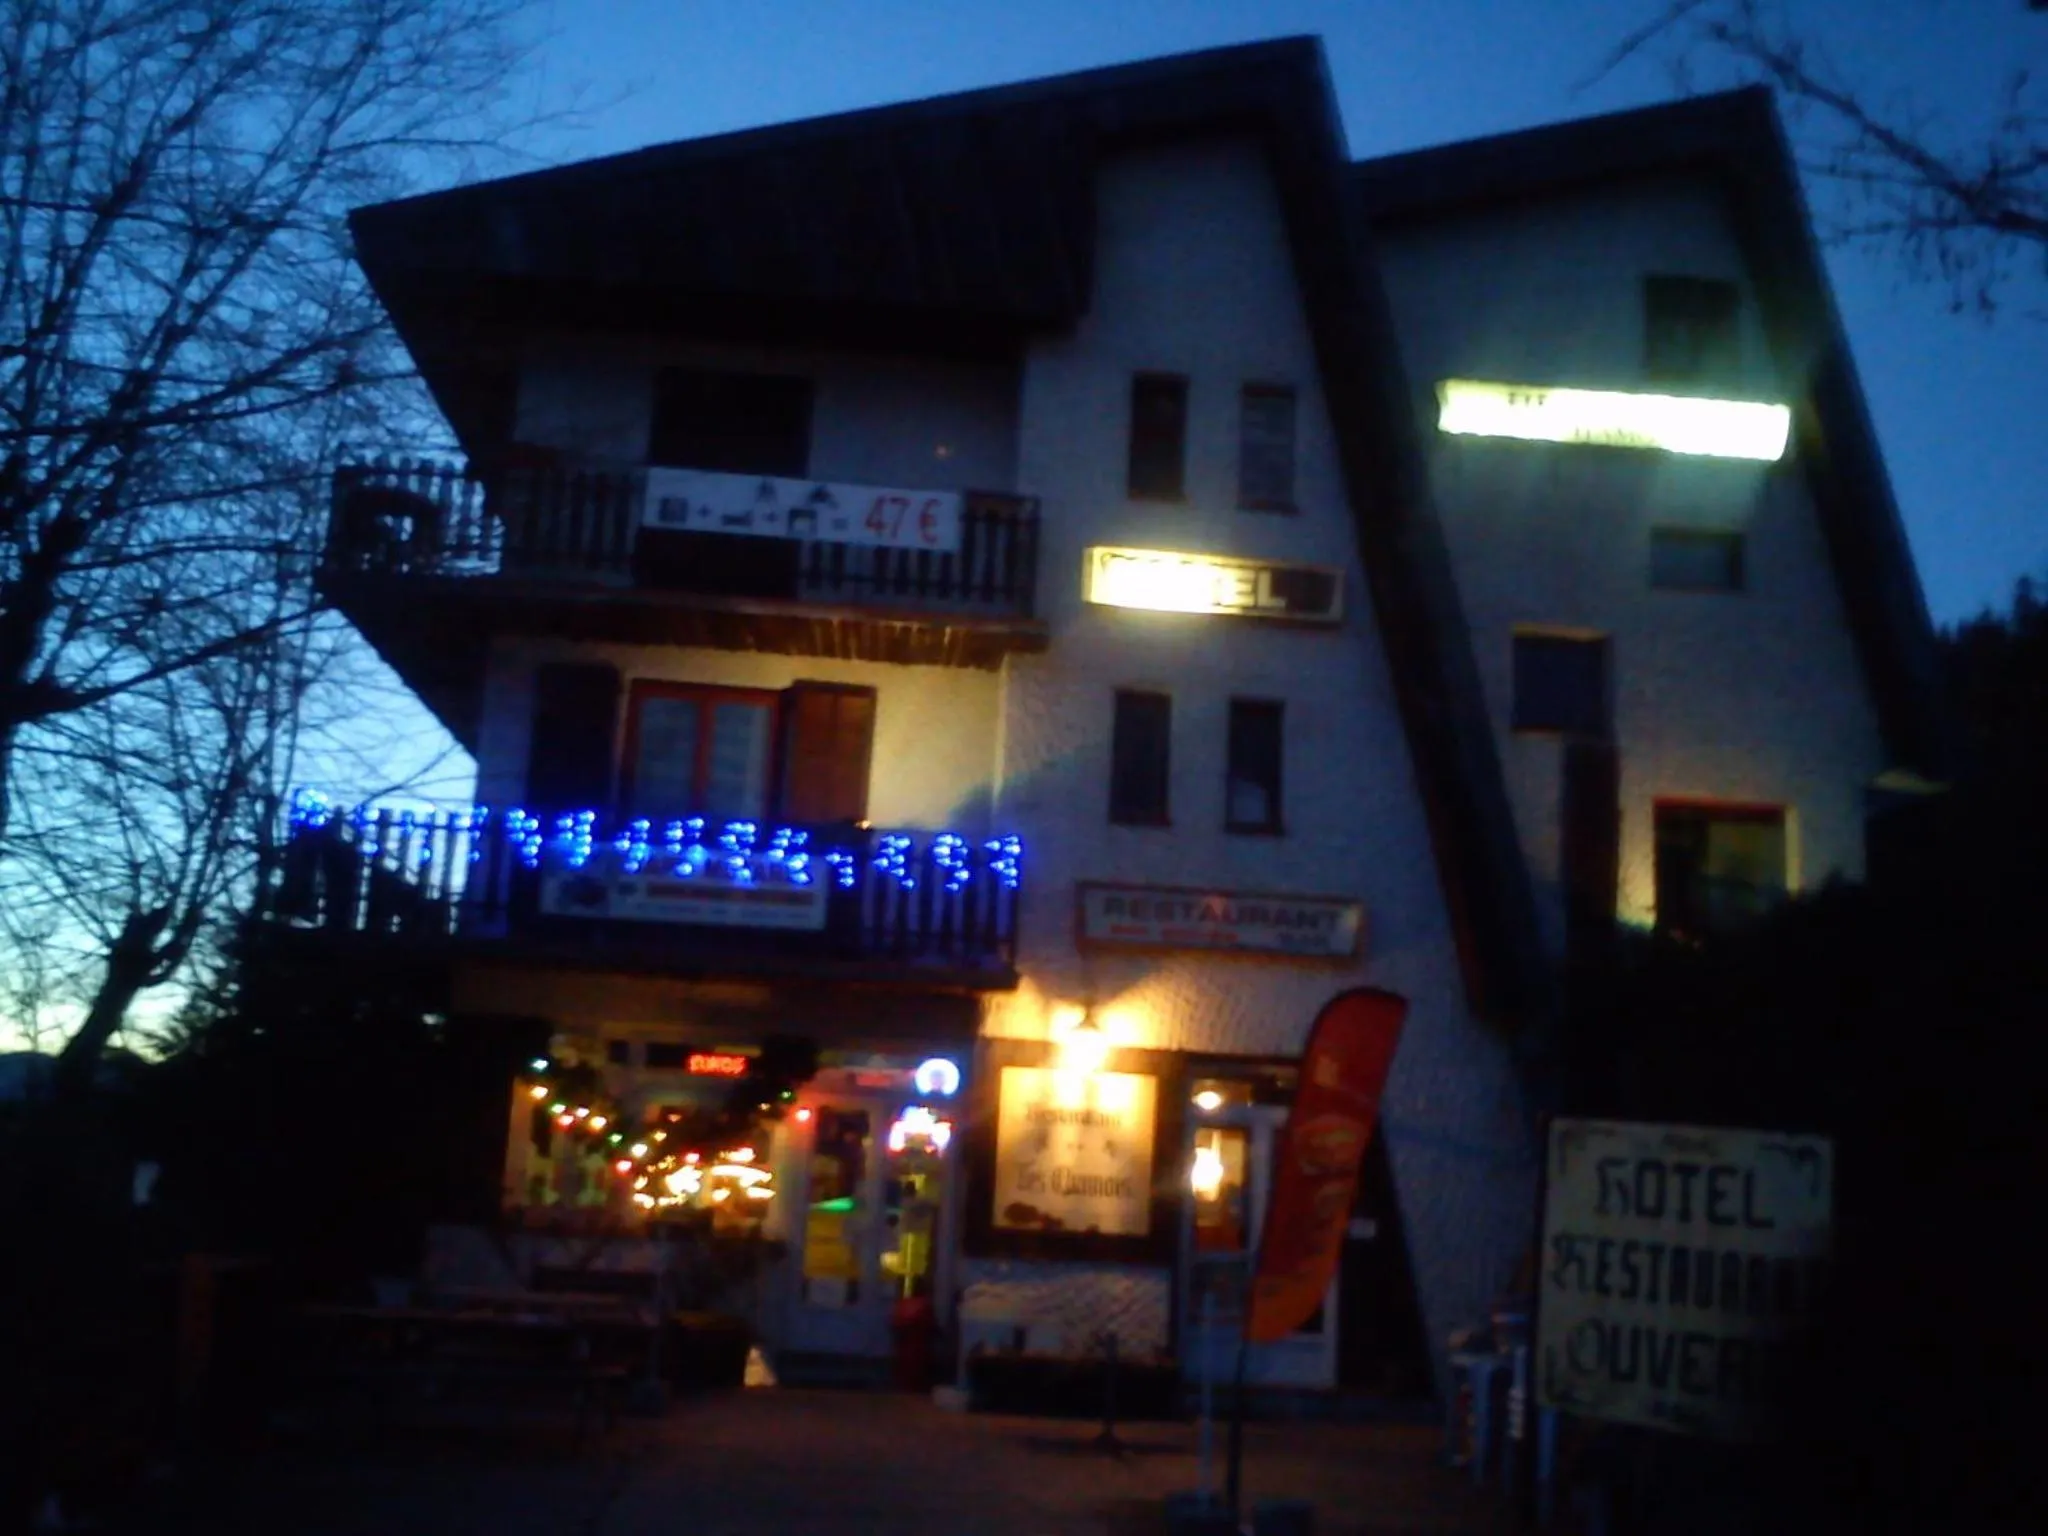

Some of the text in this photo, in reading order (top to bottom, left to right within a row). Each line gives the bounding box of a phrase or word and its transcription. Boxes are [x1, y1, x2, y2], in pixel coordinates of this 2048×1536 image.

[865, 495, 943, 544] 47 €
[1103, 895, 1341, 932] RESTAURANT
[1595, 1157, 1775, 1229] HOTEL
